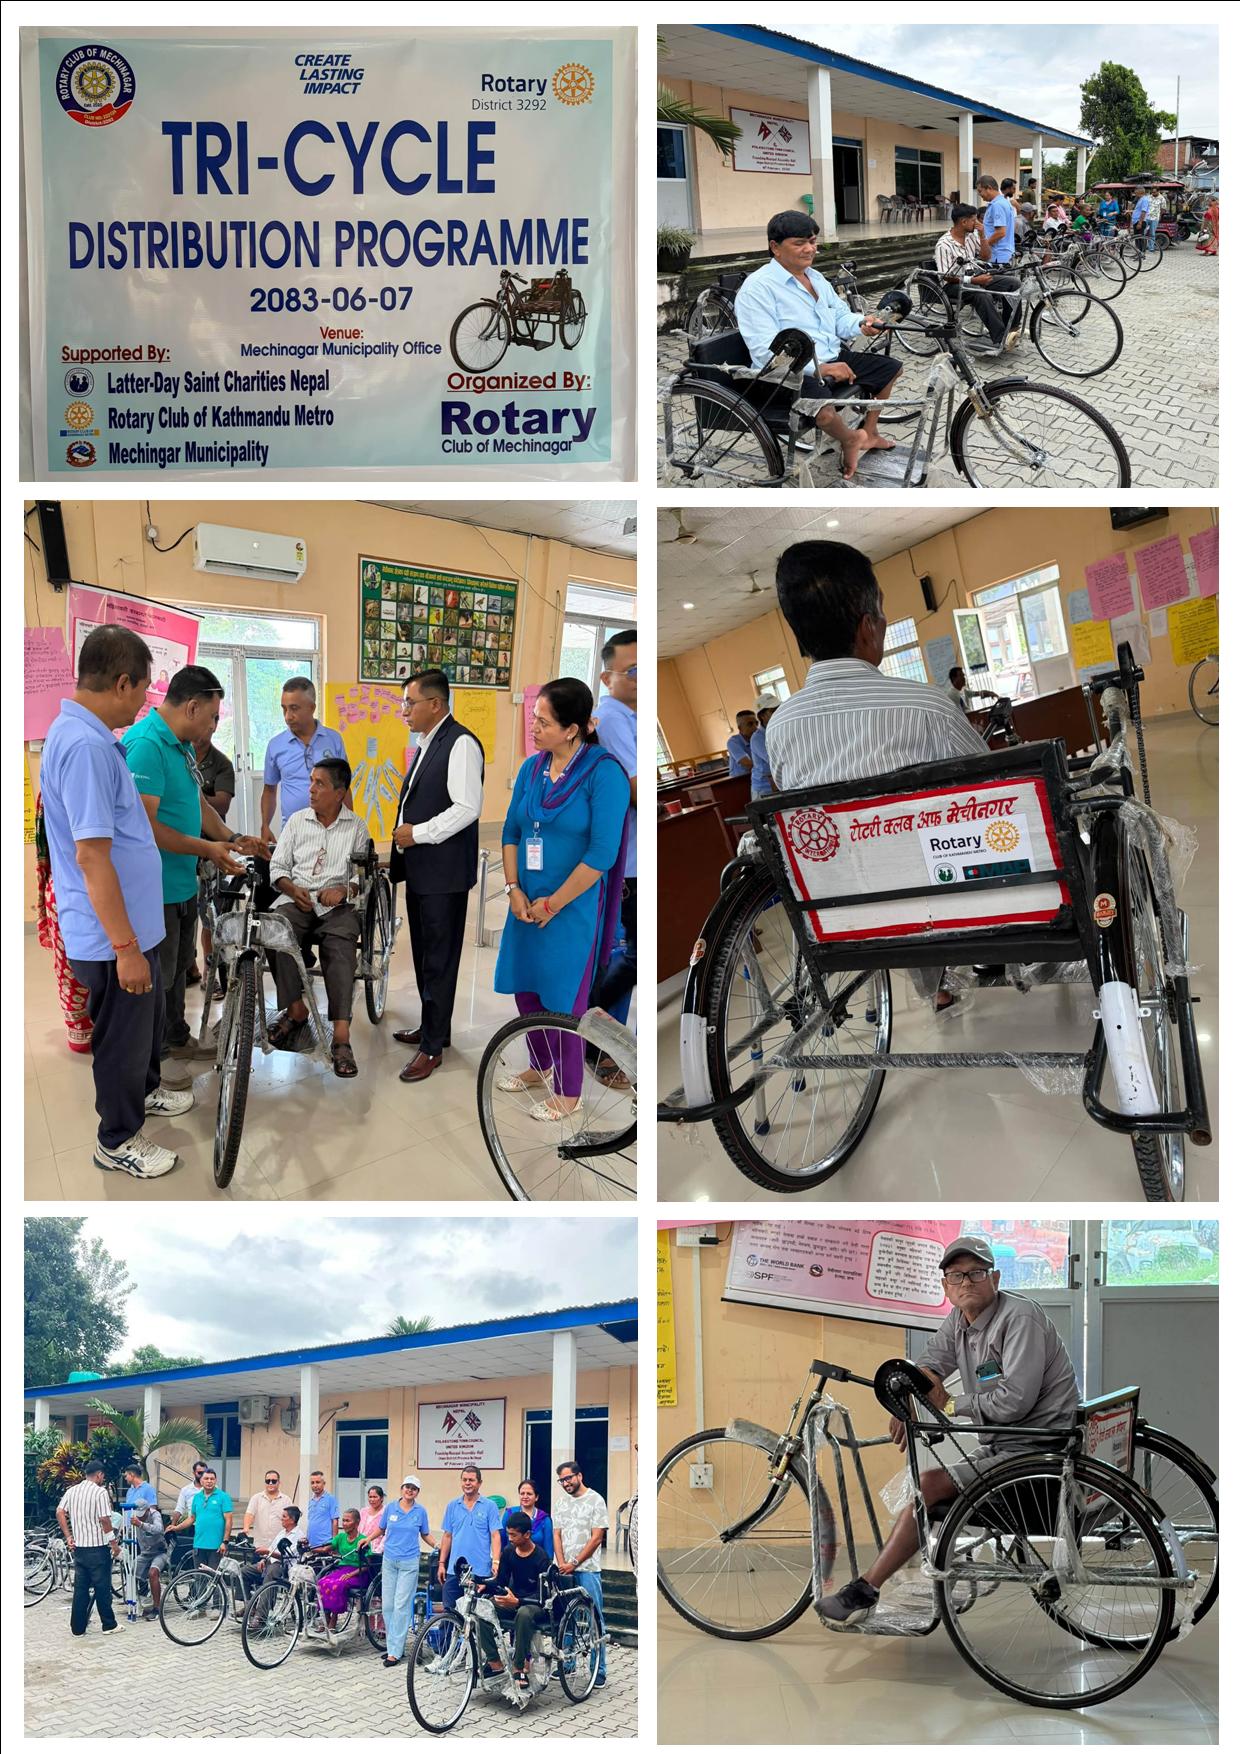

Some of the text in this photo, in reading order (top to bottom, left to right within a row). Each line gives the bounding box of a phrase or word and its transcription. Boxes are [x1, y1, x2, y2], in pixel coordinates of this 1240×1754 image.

[294, 54, 352, 68] CREATE
[59, 48, 132, 100] ROTARY CLUB OF MECHINAGAR
[299, 68, 365, 81] LASTING
[303, 82, 362, 95] IMPACT
[481, 73, 548, 96] Rotary
[471, 98, 547, 111] District 3292
[161, 119, 497, 197] TRI-CYCLE
[68, 218, 589, 270] DISTRIBUTION PROGRAMME
[249, 286, 413, 313] 2083-06-07
[319, 326, 364, 340] Venue:
[61, 344, 171, 364] Supported By:
[240, 340, 442, 359] Mechinagar Municipality Office
[107, 369, 330, 398] Latter-Day Saint Charities Nepal
[447, 371, 592, 394] Organized By:
[108, 404, 334, 434] Rotary Club of Kathmandu Metro
[440, 400, 598, 443] Rotary
[108, 440, 269, 470] Mechingar Municipality
[441, 438, 573, 456] Club of Mechinagar
[795, 813, 823, 825] ROTARY
[849, 814, 881, 842] रोटरी
[917, 810, 943, 829] अफ
[946, 796, 1019, 824] मेचीनगर
[929, 834, 982, 852] Rotary
[790, 1261, 806, 1269] BANK
[753, 1271, 774, 1281] SPF
